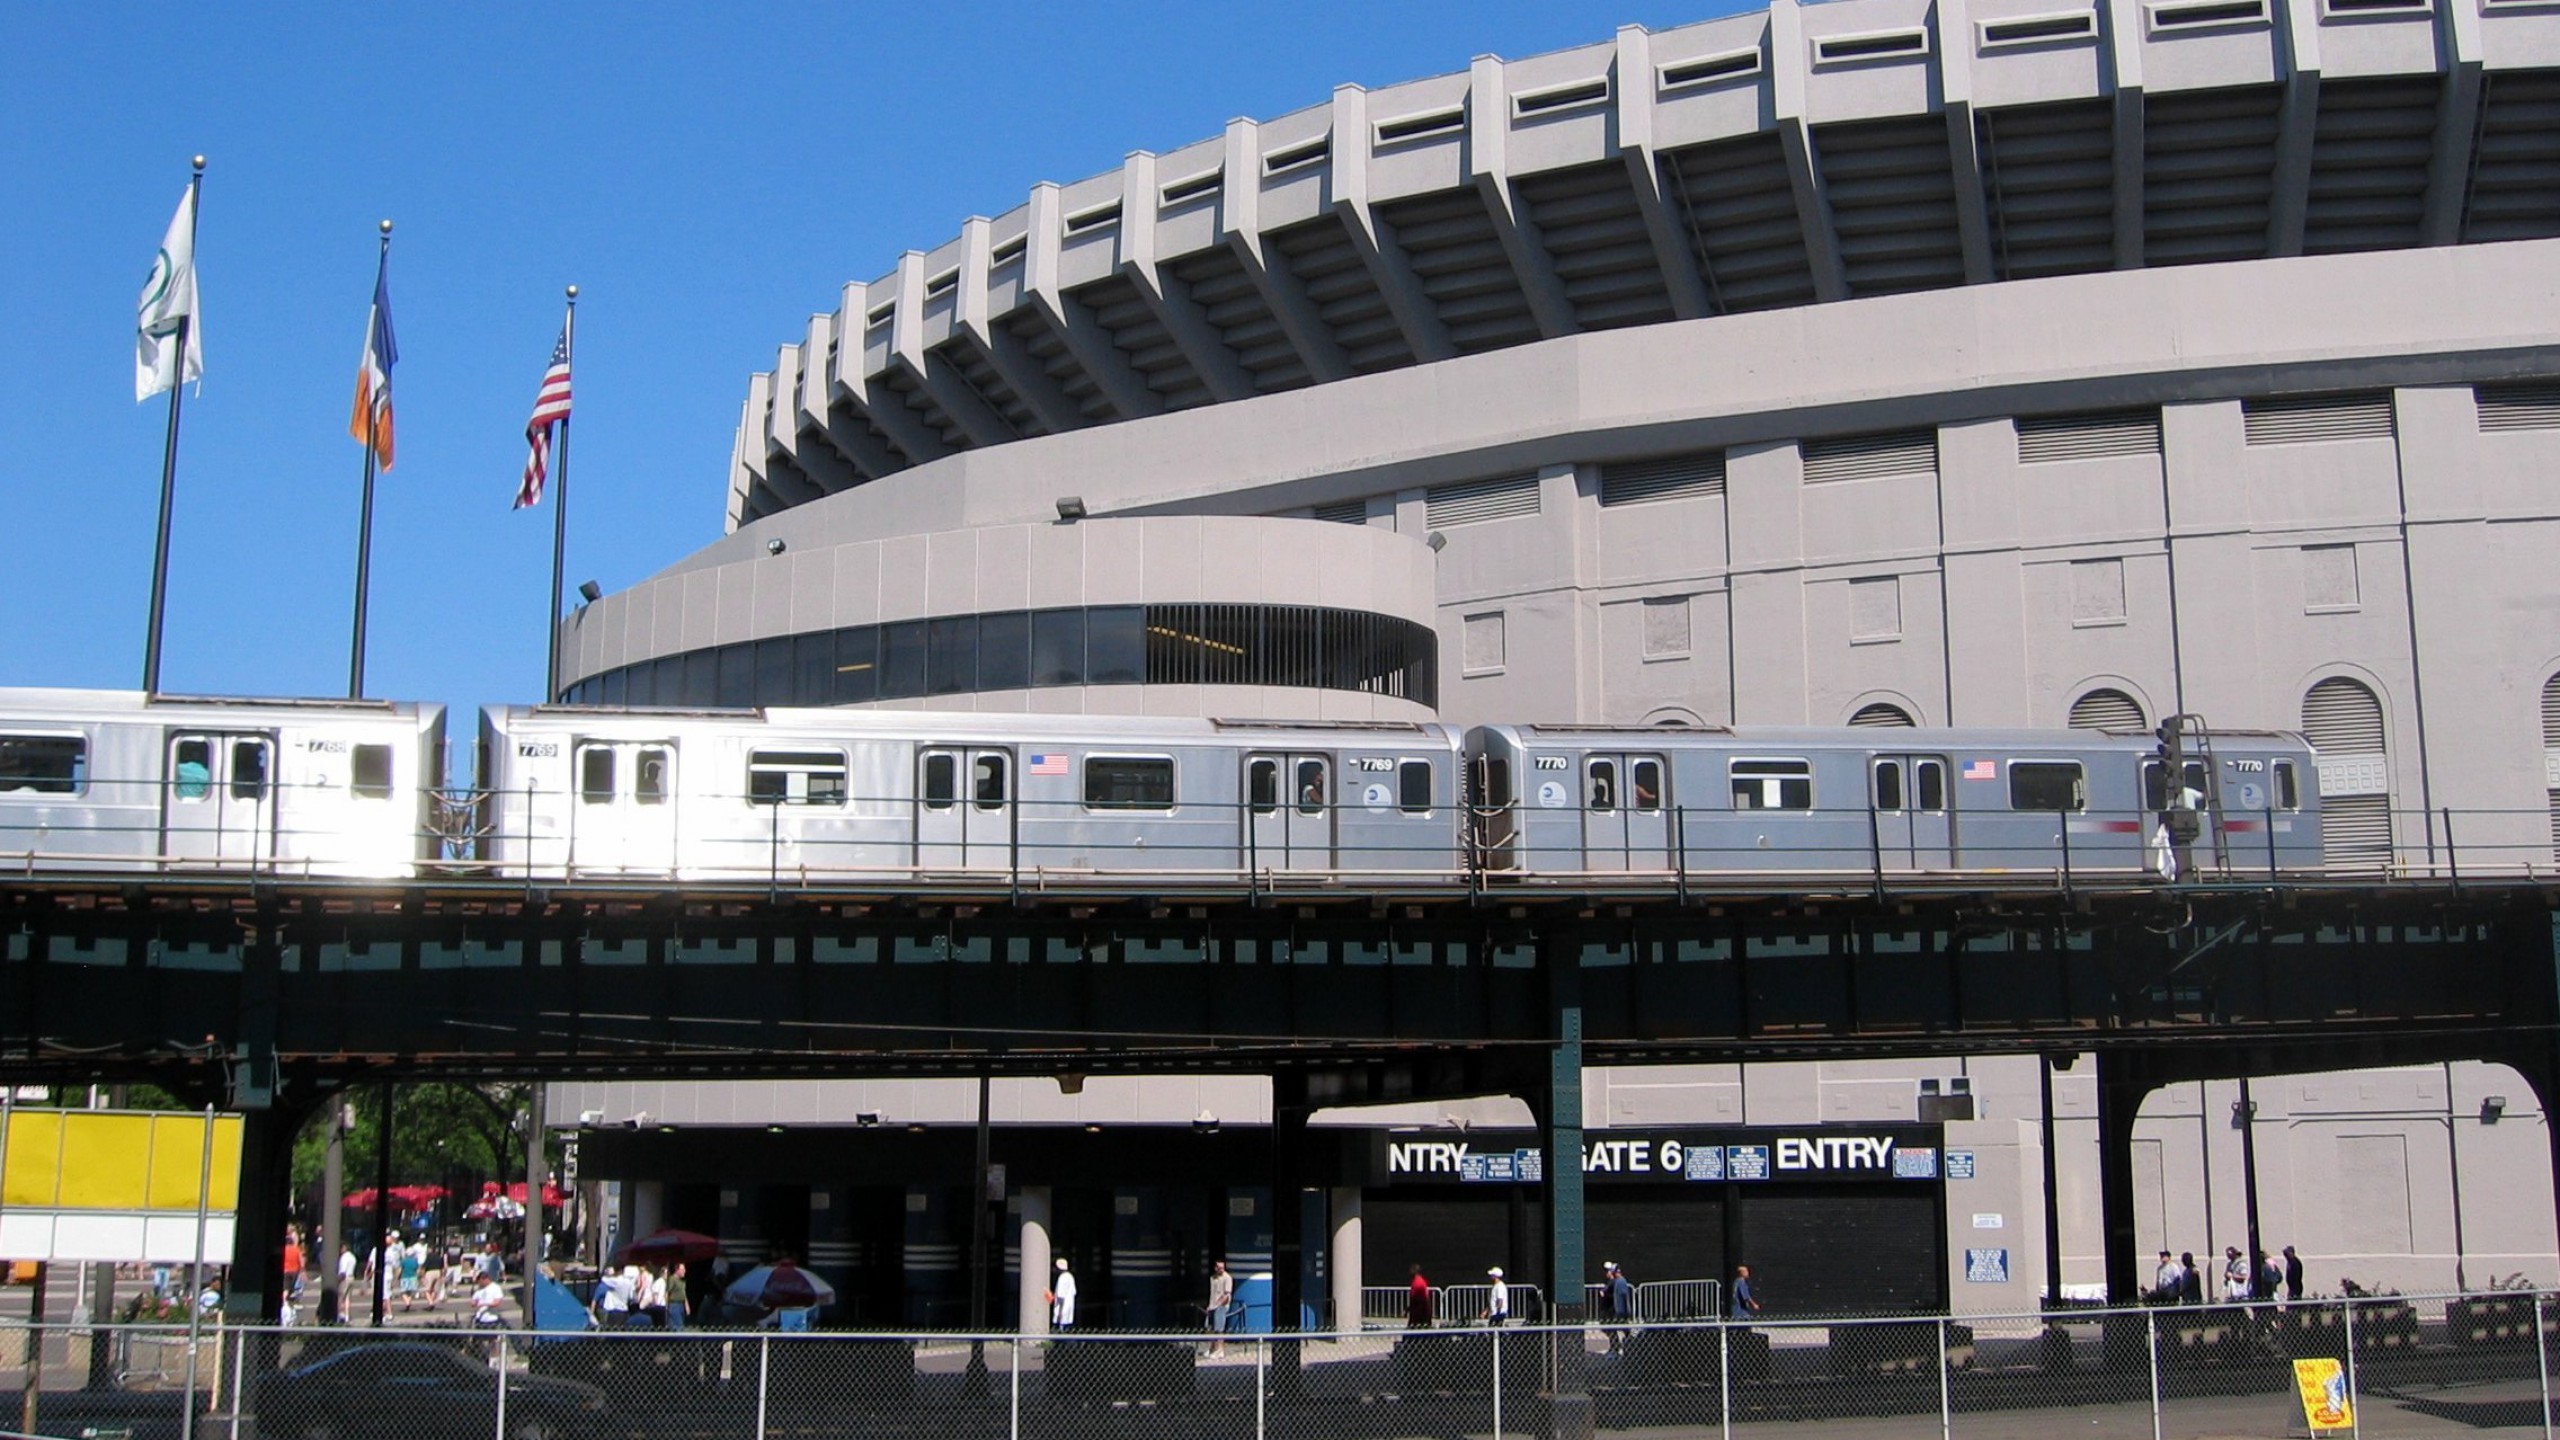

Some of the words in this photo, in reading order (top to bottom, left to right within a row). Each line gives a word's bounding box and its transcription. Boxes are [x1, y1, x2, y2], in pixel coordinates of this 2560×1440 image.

[520, 744, 557, 757] 7769
[1361, 758, 1393, 771] 7769
[1536, 756, 1567, 769] 7770
[2237, 760, 2263, 772] 7770
[1389, 1143, 1468, 1172] NTRY
[1660, 1140, 1683, 1172] 6
[1777, 1137, 1893, 1169] ENTRY
